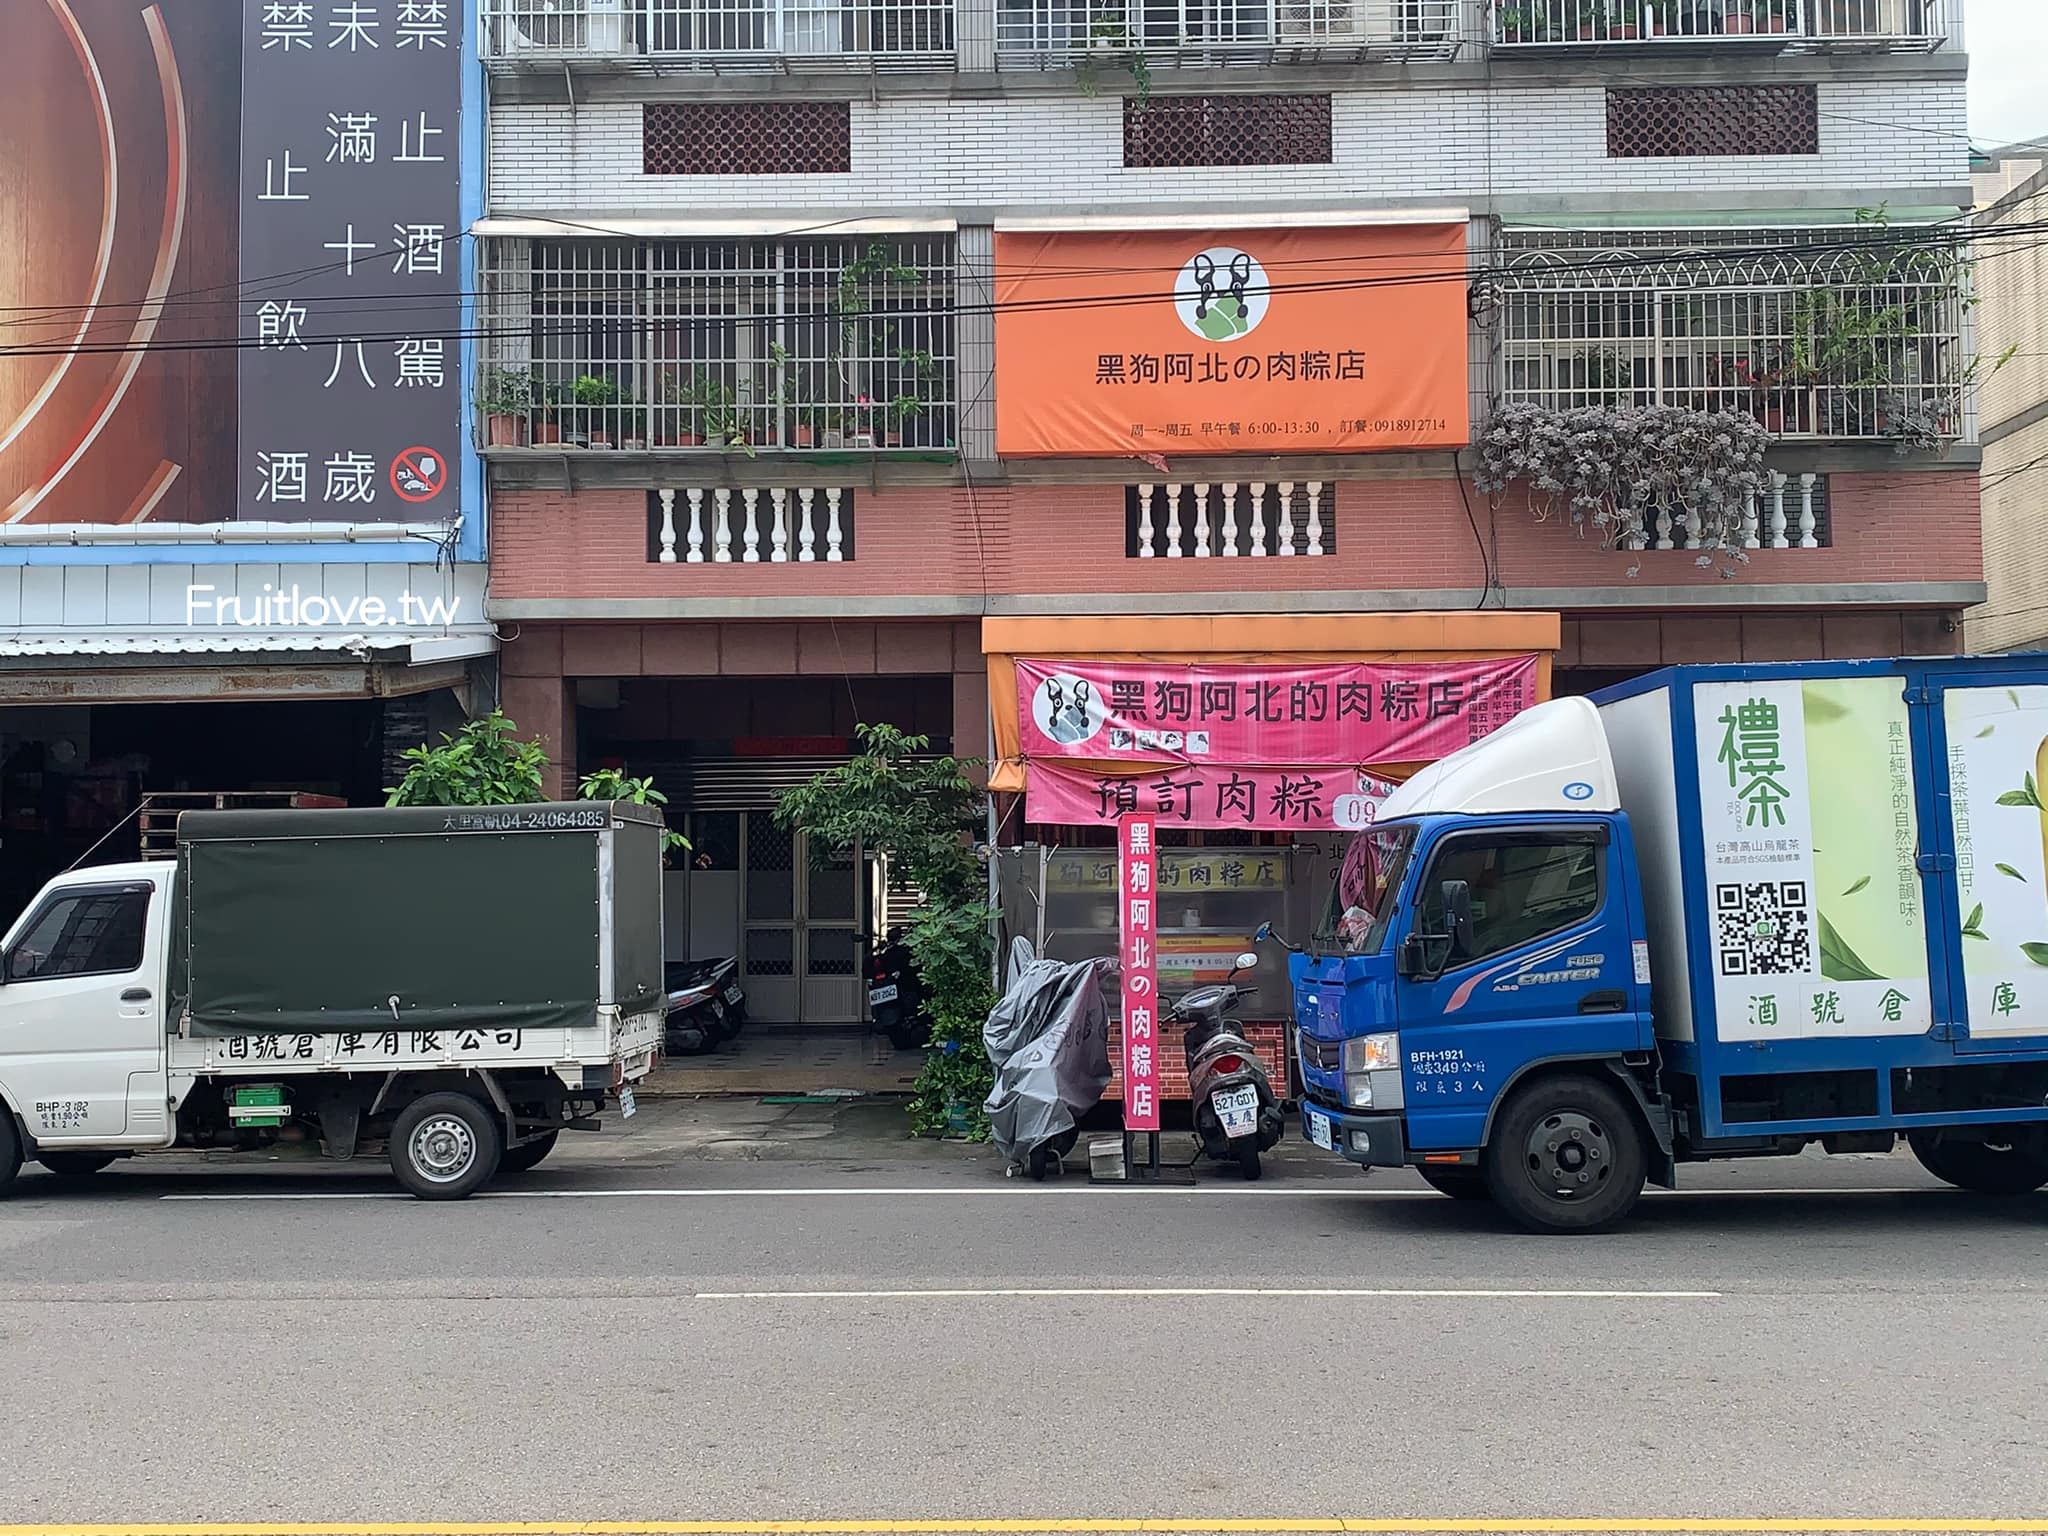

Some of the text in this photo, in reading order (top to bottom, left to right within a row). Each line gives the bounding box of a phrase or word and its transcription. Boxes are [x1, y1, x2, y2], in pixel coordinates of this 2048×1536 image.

[391, 1, 447, 388] 禁止酒駕
[255, 1, 313, 502] 禁止飲酒
[323, 2, 378, 502] 未滿十八歲
[1095, 349, 1366, 385] 黑狗阿北の肉粽店
[1110, 678, 1464, 722] 黑狗阿北的肉粽店
[1091, 773, 1323, 821] 預訂肉粽
[1130, 822, 1152, 1118] 黑狗阿北の肉粽店
[1517, 967, 1600, 986] CANTER
[1566, 953, 1605, 968] FUSO
[1410, 1049, 1464, 1063] BFH-1921
[1214, 1091, 1256, 1111] 527-GDY
